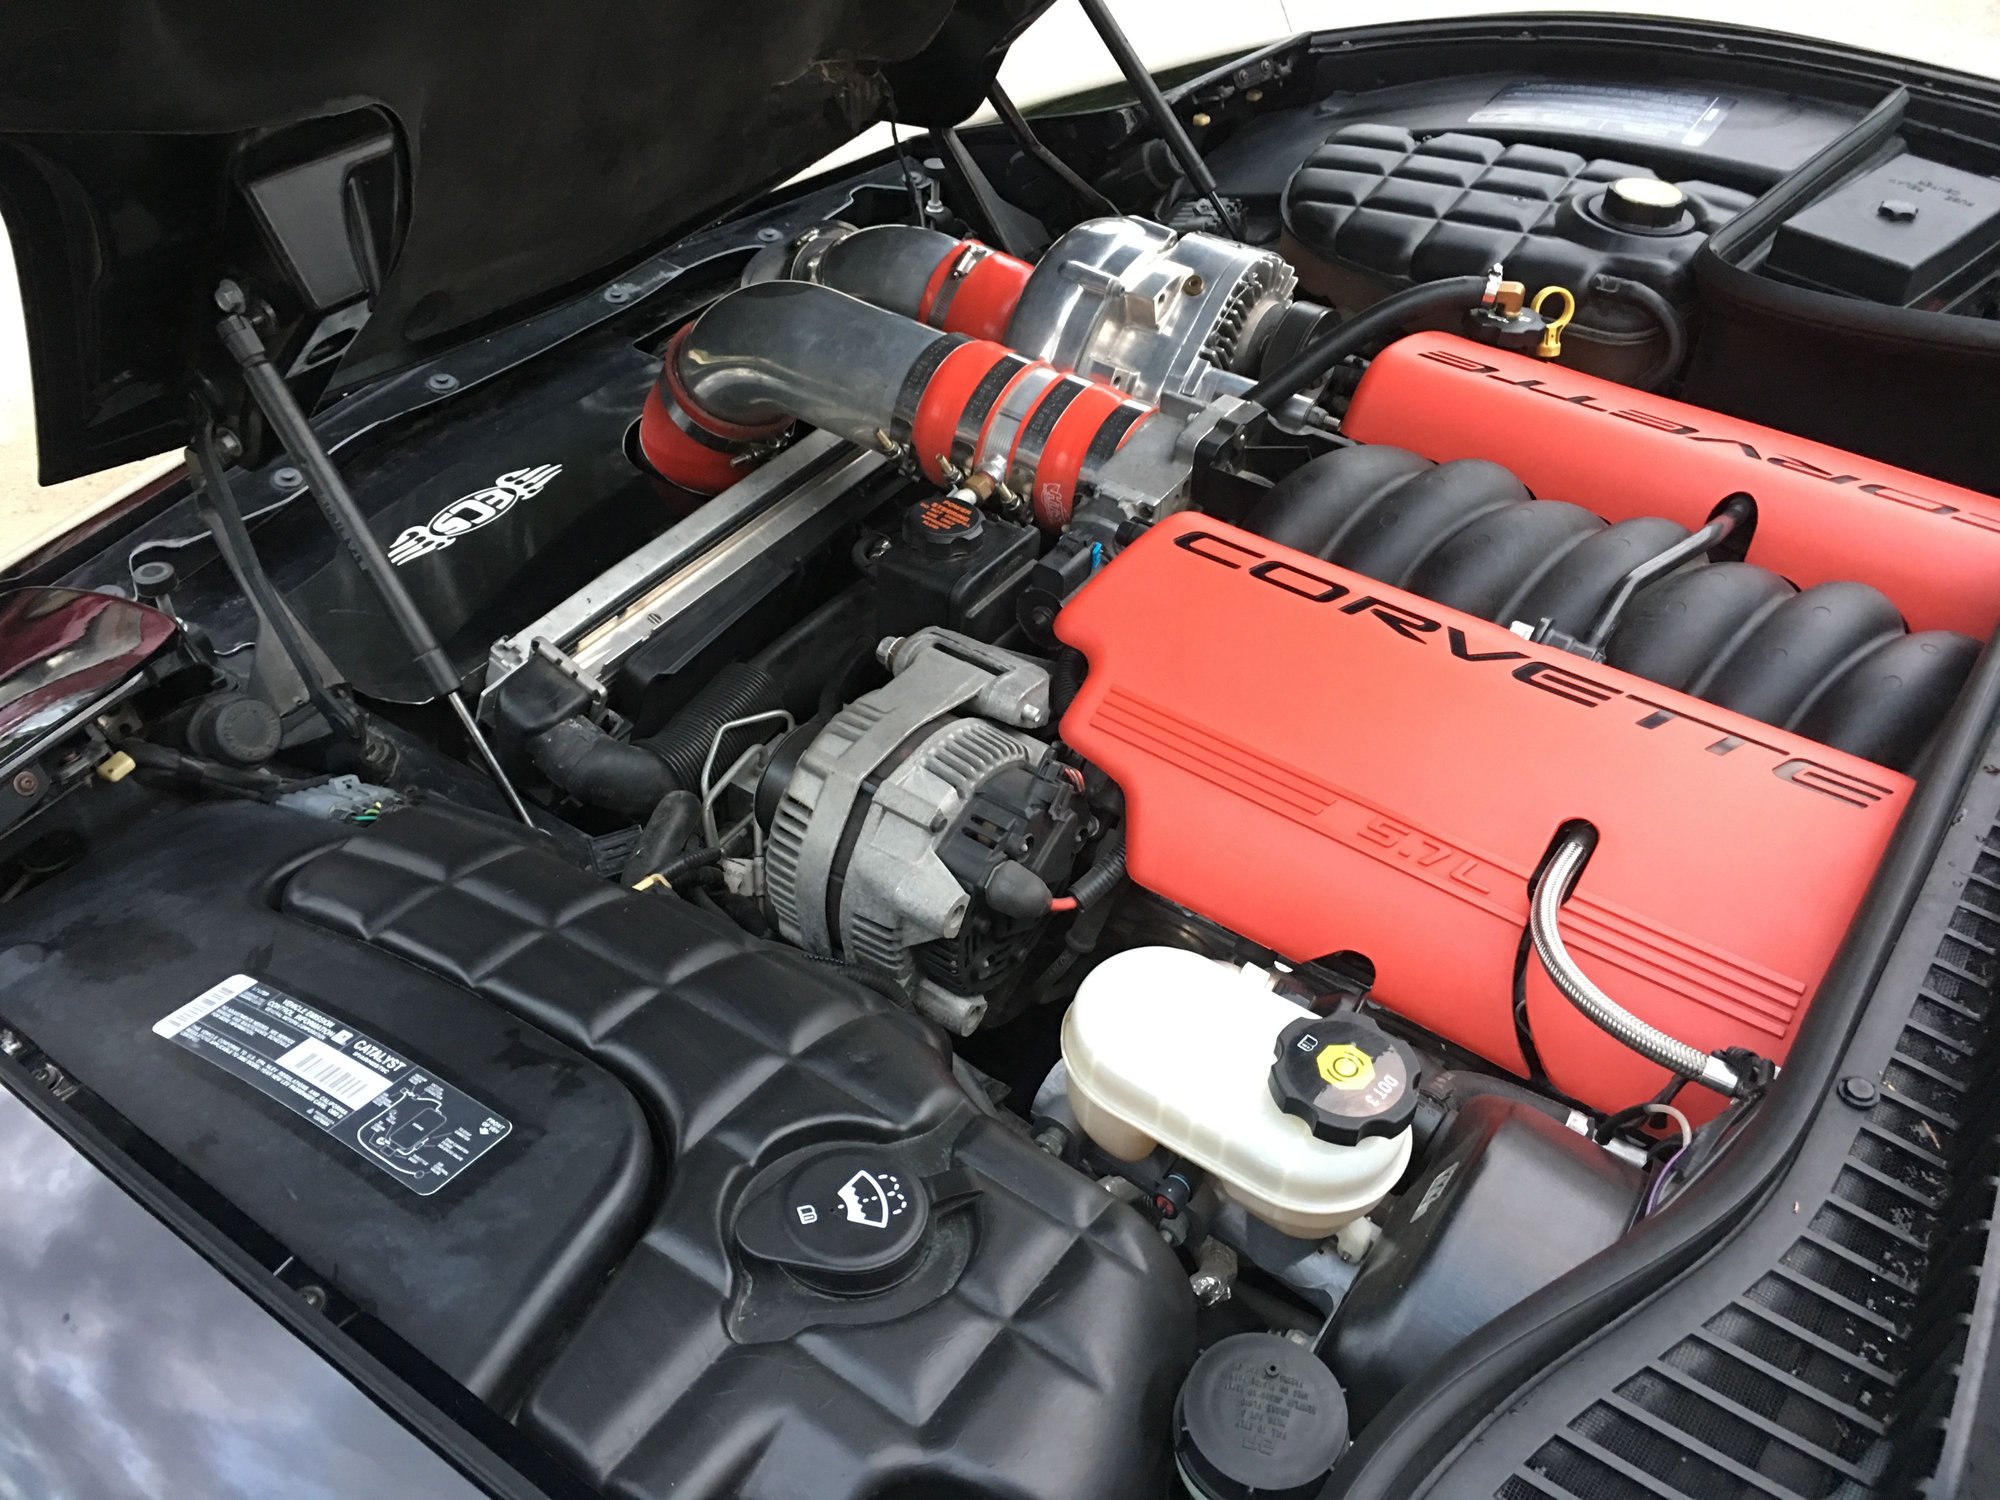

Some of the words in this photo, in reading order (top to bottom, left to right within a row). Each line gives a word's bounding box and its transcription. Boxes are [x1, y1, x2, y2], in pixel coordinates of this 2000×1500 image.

[1173, 531, 1894, 809] CORVETTE
[1356, 817, 1492, 894] 5.7L
[267, 1000, 295, 1018] CONTROL
[294, 1014, 336, 1037] INFORMATION
[282, 999, 308, 1014] VEHICLE
[305, 1010, 335, 1028] EMISSION
[353, 1040, 407, 1071] CATALYST
[1365, 1094, 1380, 1107] 3
[1373, 1073, 1399, 1099] DOT
